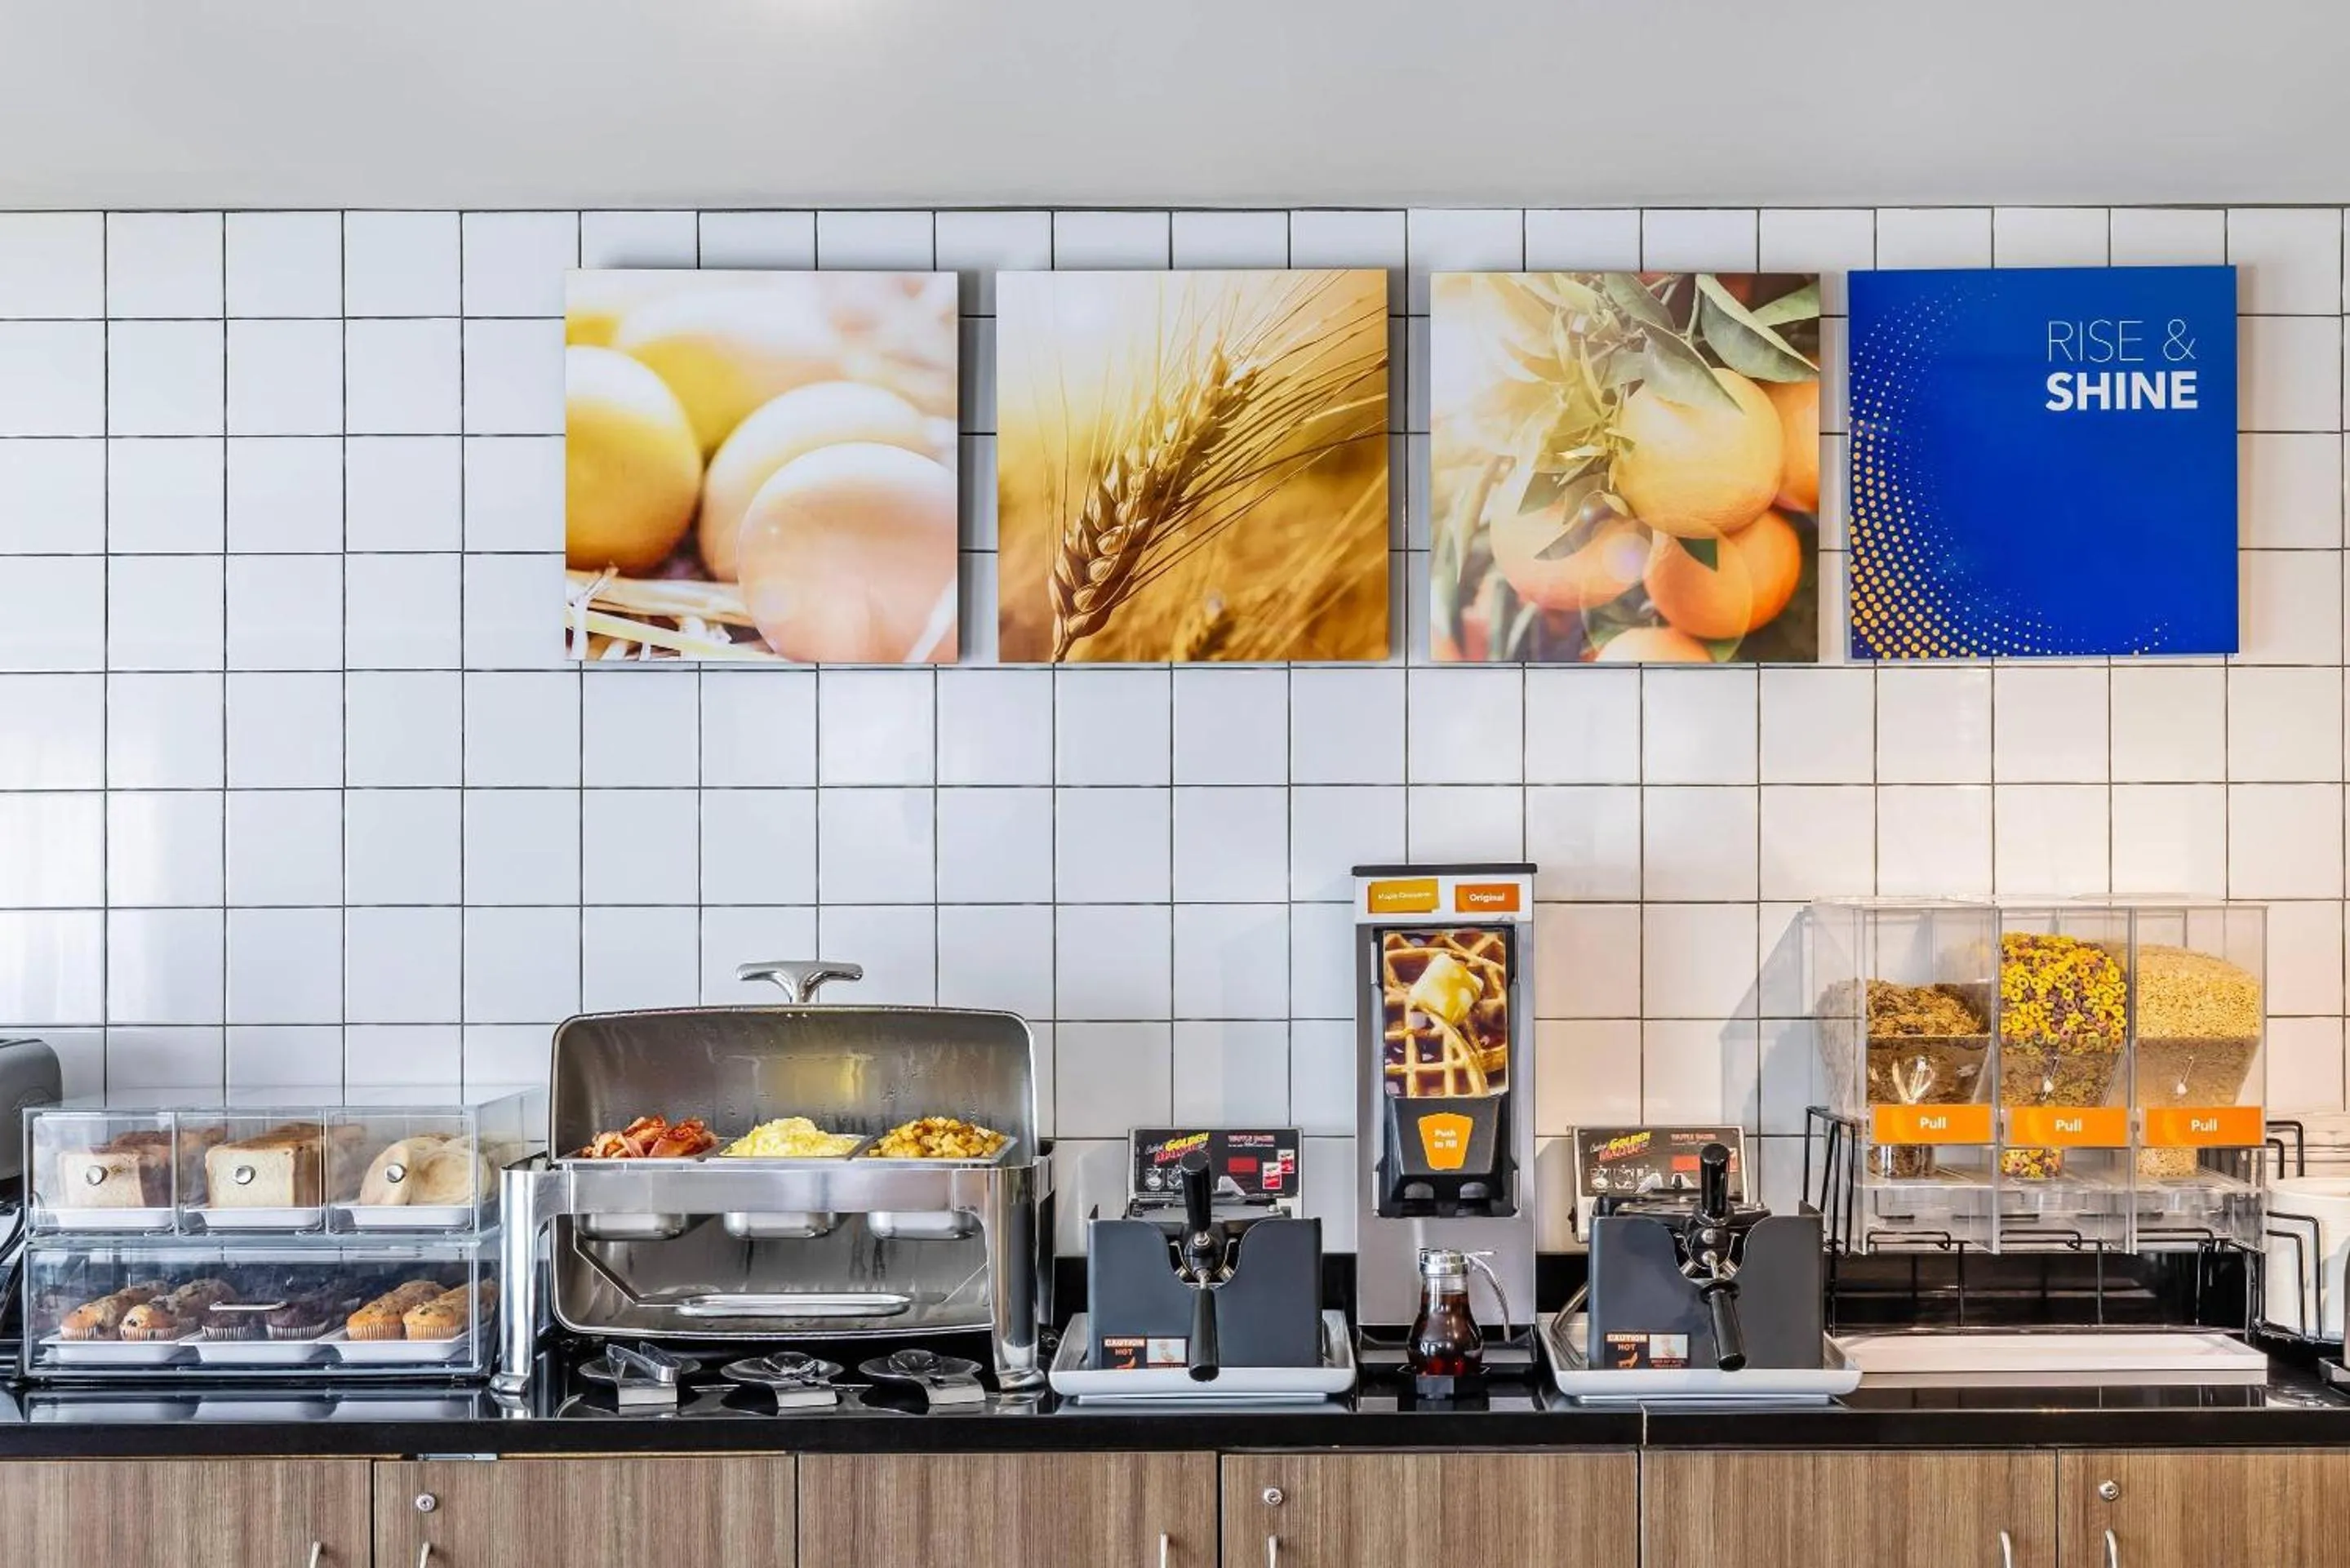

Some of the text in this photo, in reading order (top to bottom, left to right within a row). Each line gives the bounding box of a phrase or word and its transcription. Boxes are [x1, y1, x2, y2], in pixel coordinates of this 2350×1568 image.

[2048, 318, 2197, 362] RISE &
[2045, 371, 2198, 411] SHINE
[1469, 893, 1505, 903] Original
[1920, 1116, 1947, 1129] Pull
[2055, 1118, 2081, 1132] Pull
[2191, 1117, 2218, 1132] Pull
[1434, 1129, 1456, 1137] Push
[1165, 1131, 1209, 1152] GOLDEN
[1609, 1131, 1651, 1150] GOLDEN
[1104, 1338, 1144, 1347] CAUTION
[1606, 1334, 1647, 1343] CAUTION
[1115, 1348, 1133, 1356] HOT
